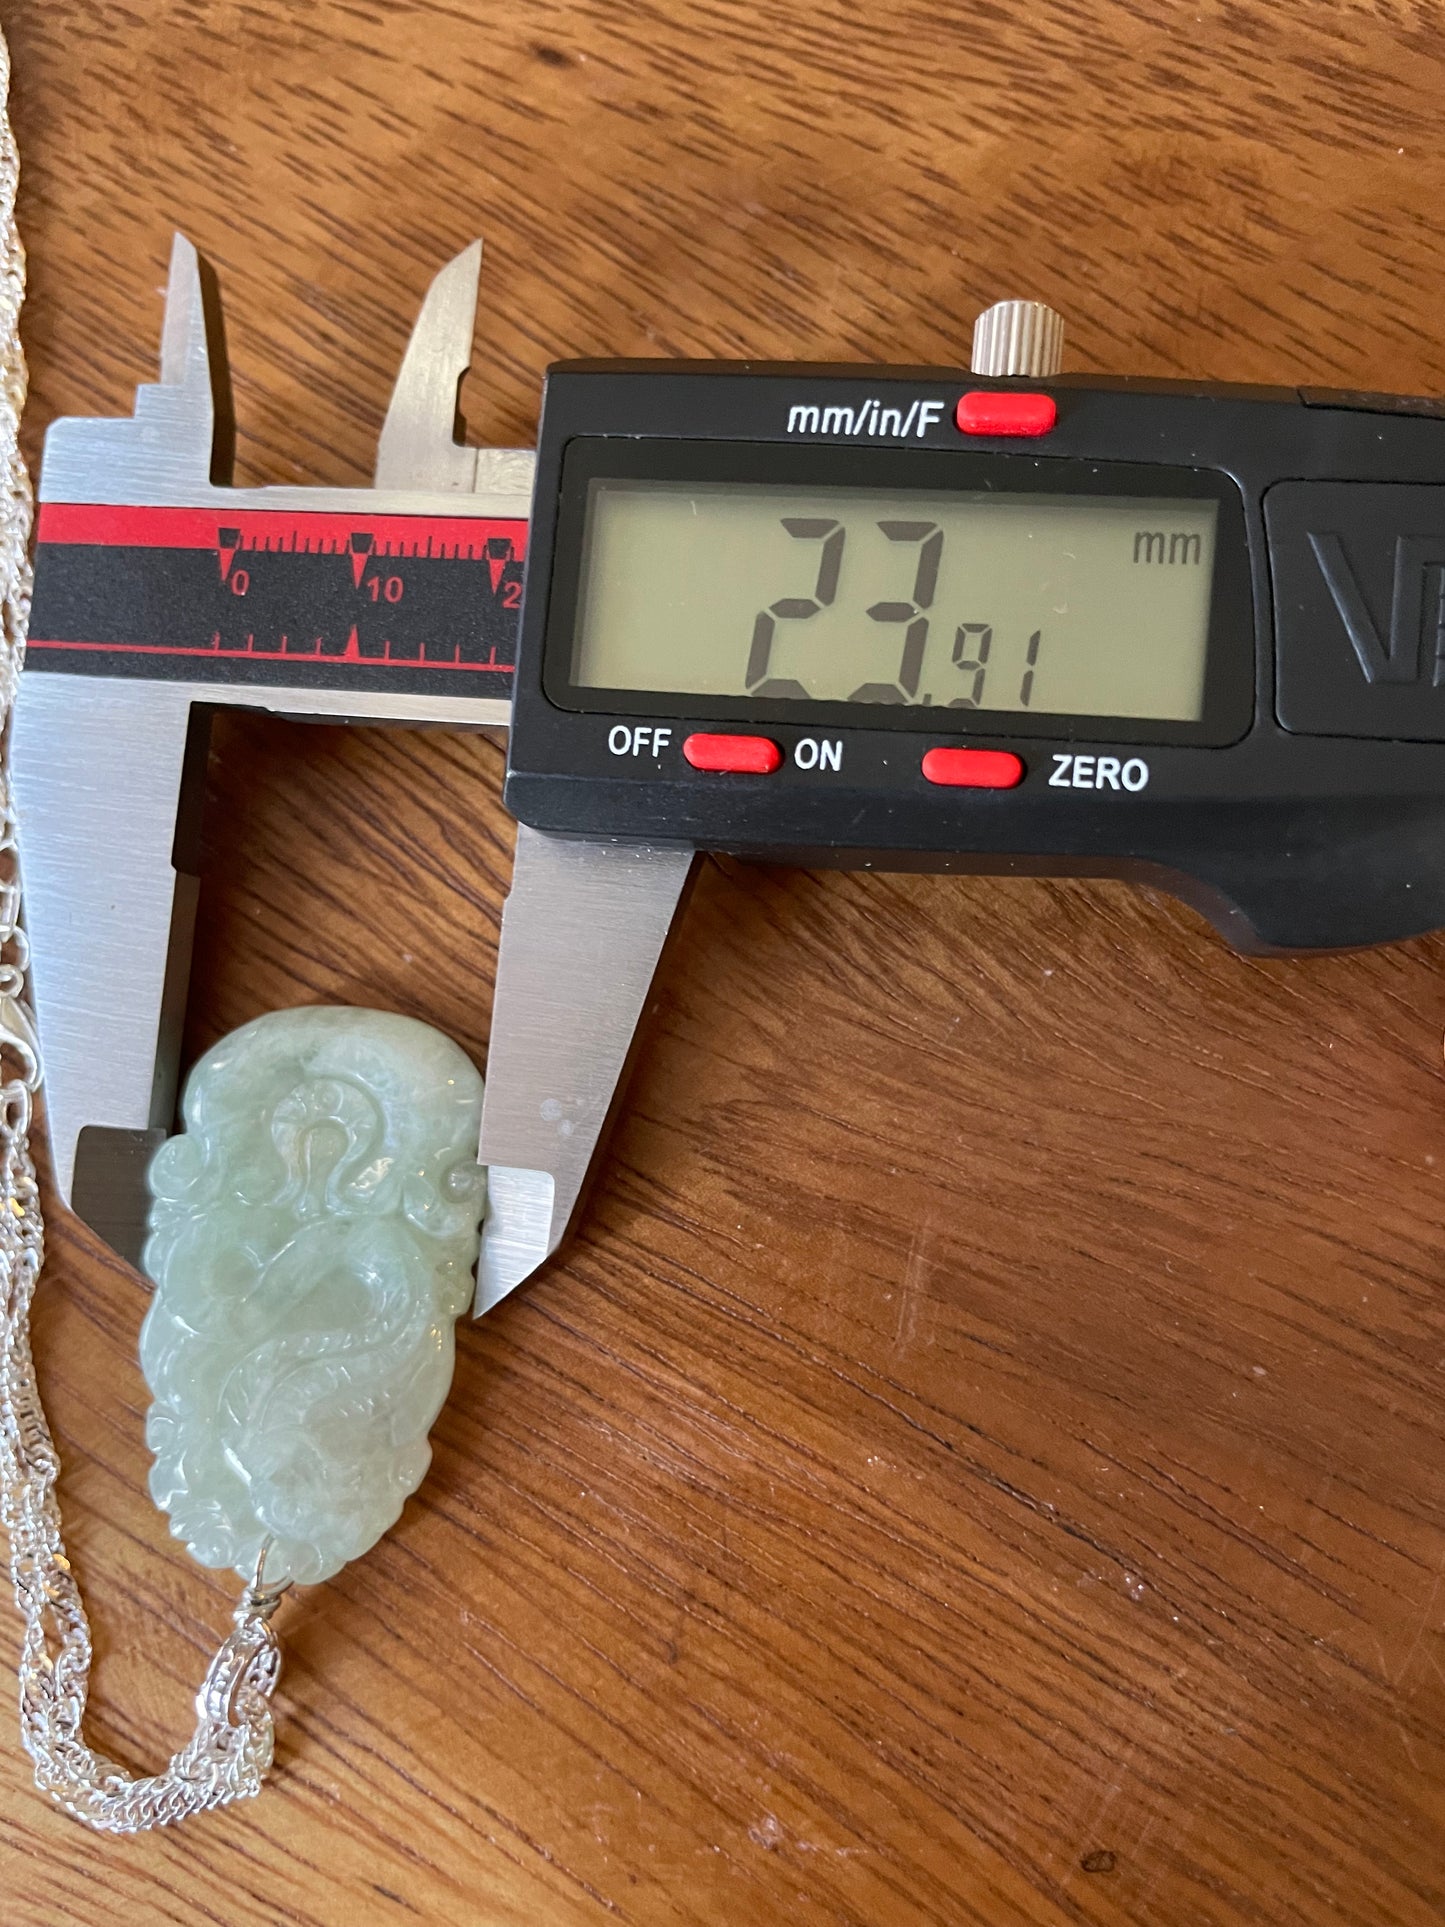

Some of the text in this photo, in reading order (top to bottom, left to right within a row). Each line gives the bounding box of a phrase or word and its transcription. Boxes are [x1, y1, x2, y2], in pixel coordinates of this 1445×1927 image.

[786, 399, 945, 438] mm/in/F
[1133, 531, 1200, 565] mm
[230, 569, 523, 609] 0 10 2
[607, 725, 843, 772] OFF ON
[1048, 753, 1150, 792] ZERO
